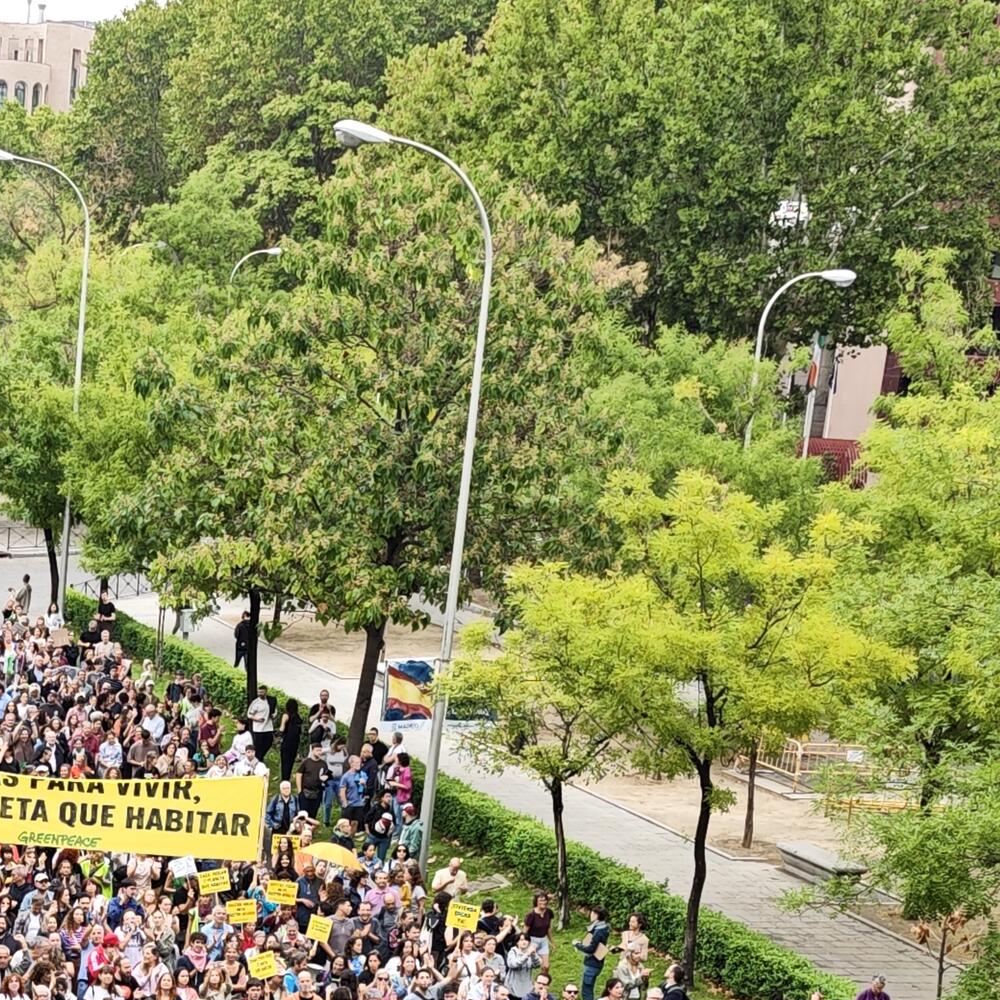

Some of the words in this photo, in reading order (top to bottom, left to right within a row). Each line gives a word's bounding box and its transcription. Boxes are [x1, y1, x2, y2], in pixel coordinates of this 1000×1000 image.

[58, 801, 116, 829] QUE
[125, 806, 252, 837] HABITAR
[17, 830, 103, 848] GREENPEACE
